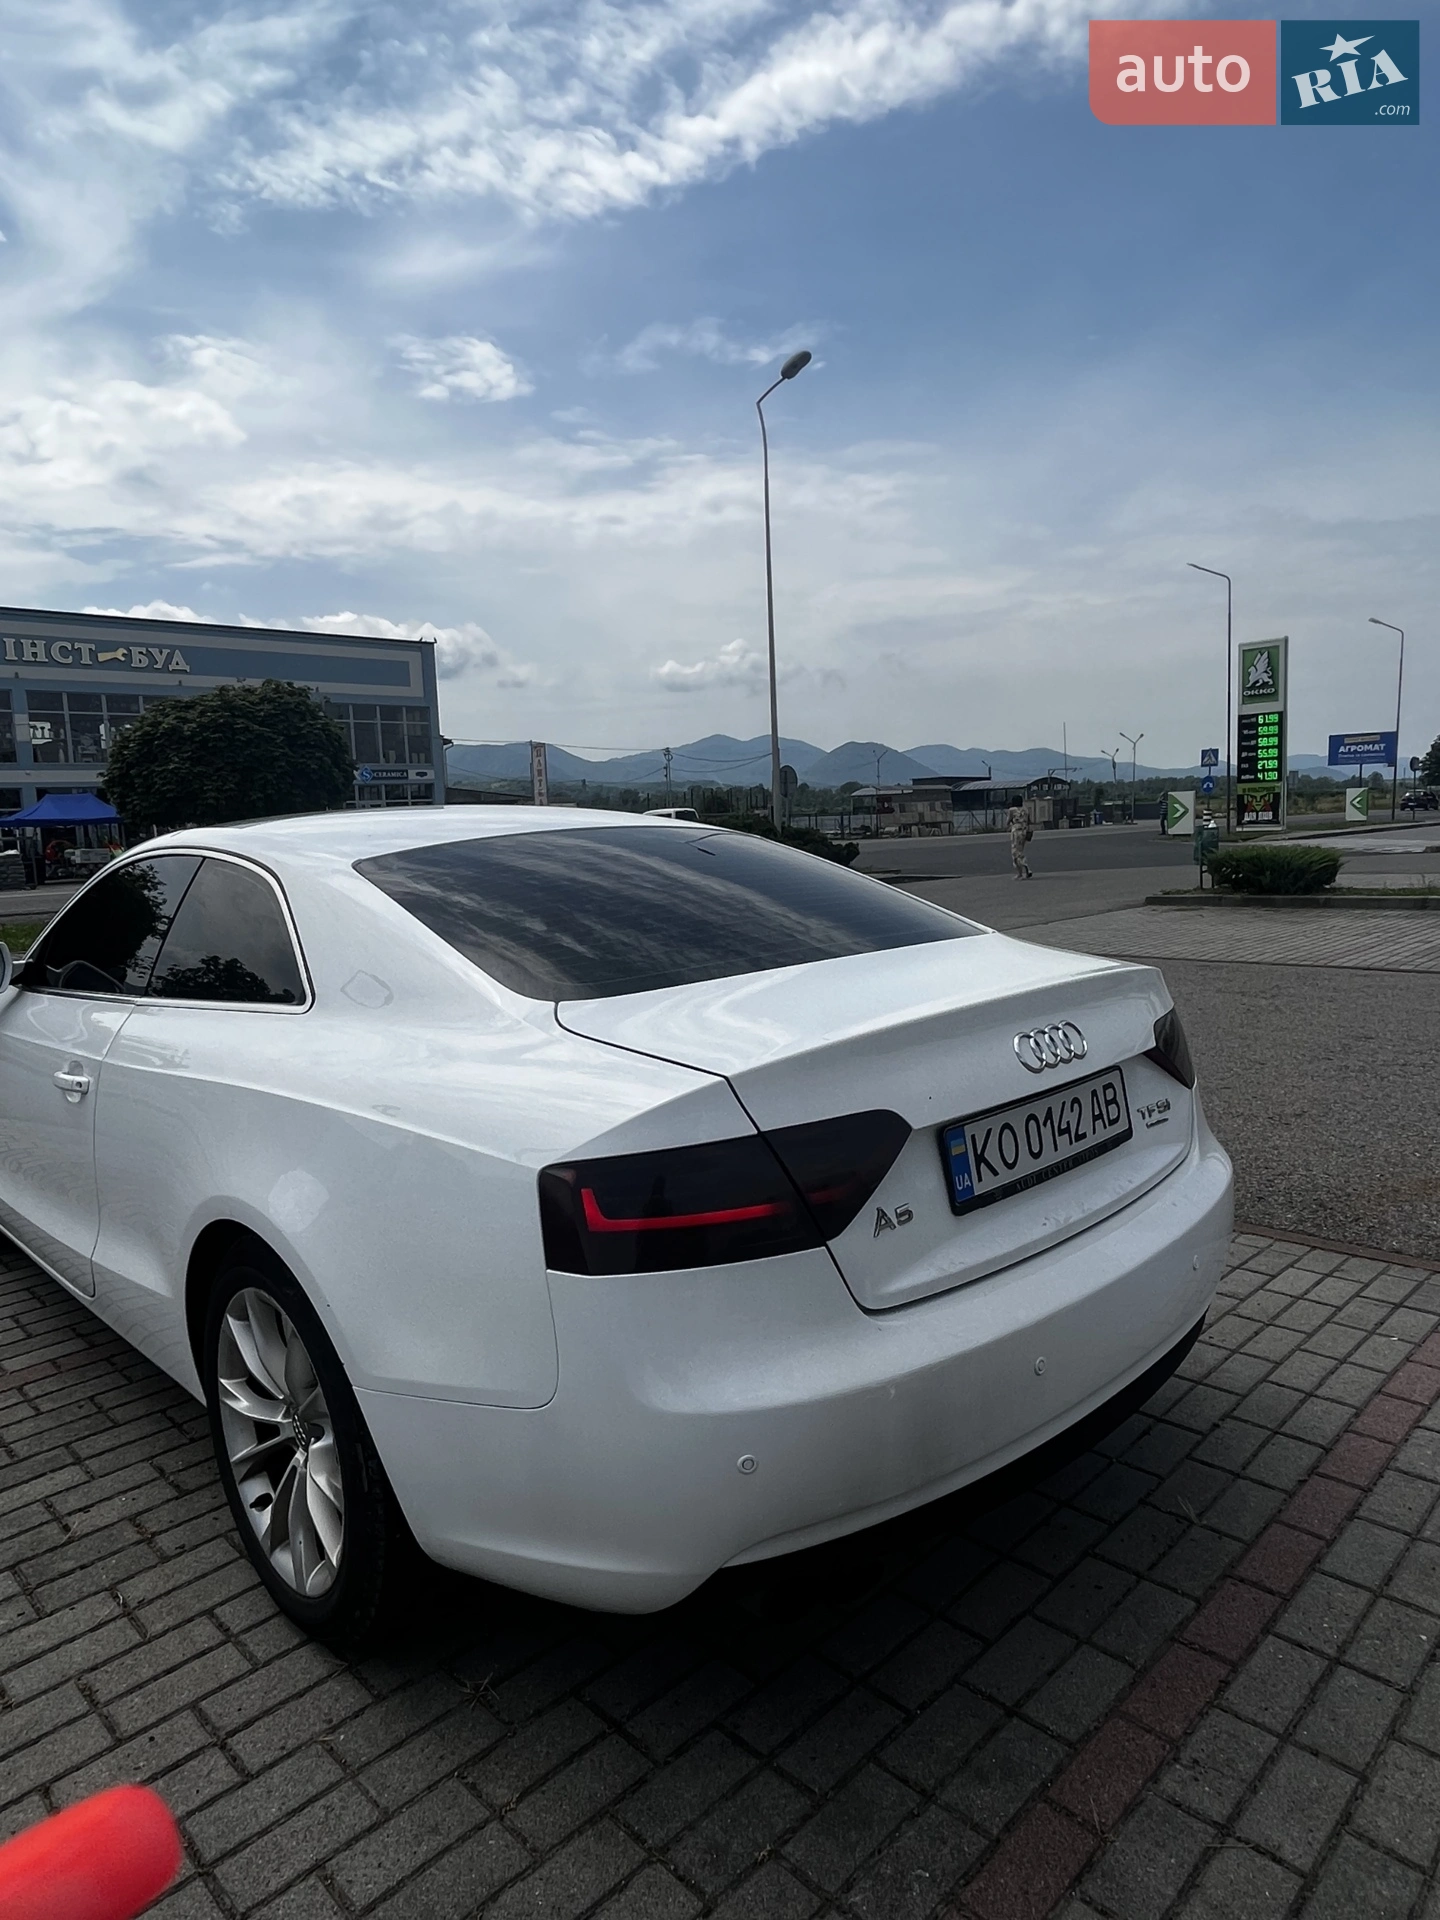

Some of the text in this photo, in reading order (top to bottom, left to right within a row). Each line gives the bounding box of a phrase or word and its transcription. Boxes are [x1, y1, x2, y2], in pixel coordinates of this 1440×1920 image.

[2, 637, 191, 673] ІНСТ БУД
[1338, 743, 1386, 753] АГРОМАТ
[970, 1081, 1122, 1183] KO 0142 AB
[955, 1174, 972, 1192] UA
[873, 1202, 914, 1239] A5
